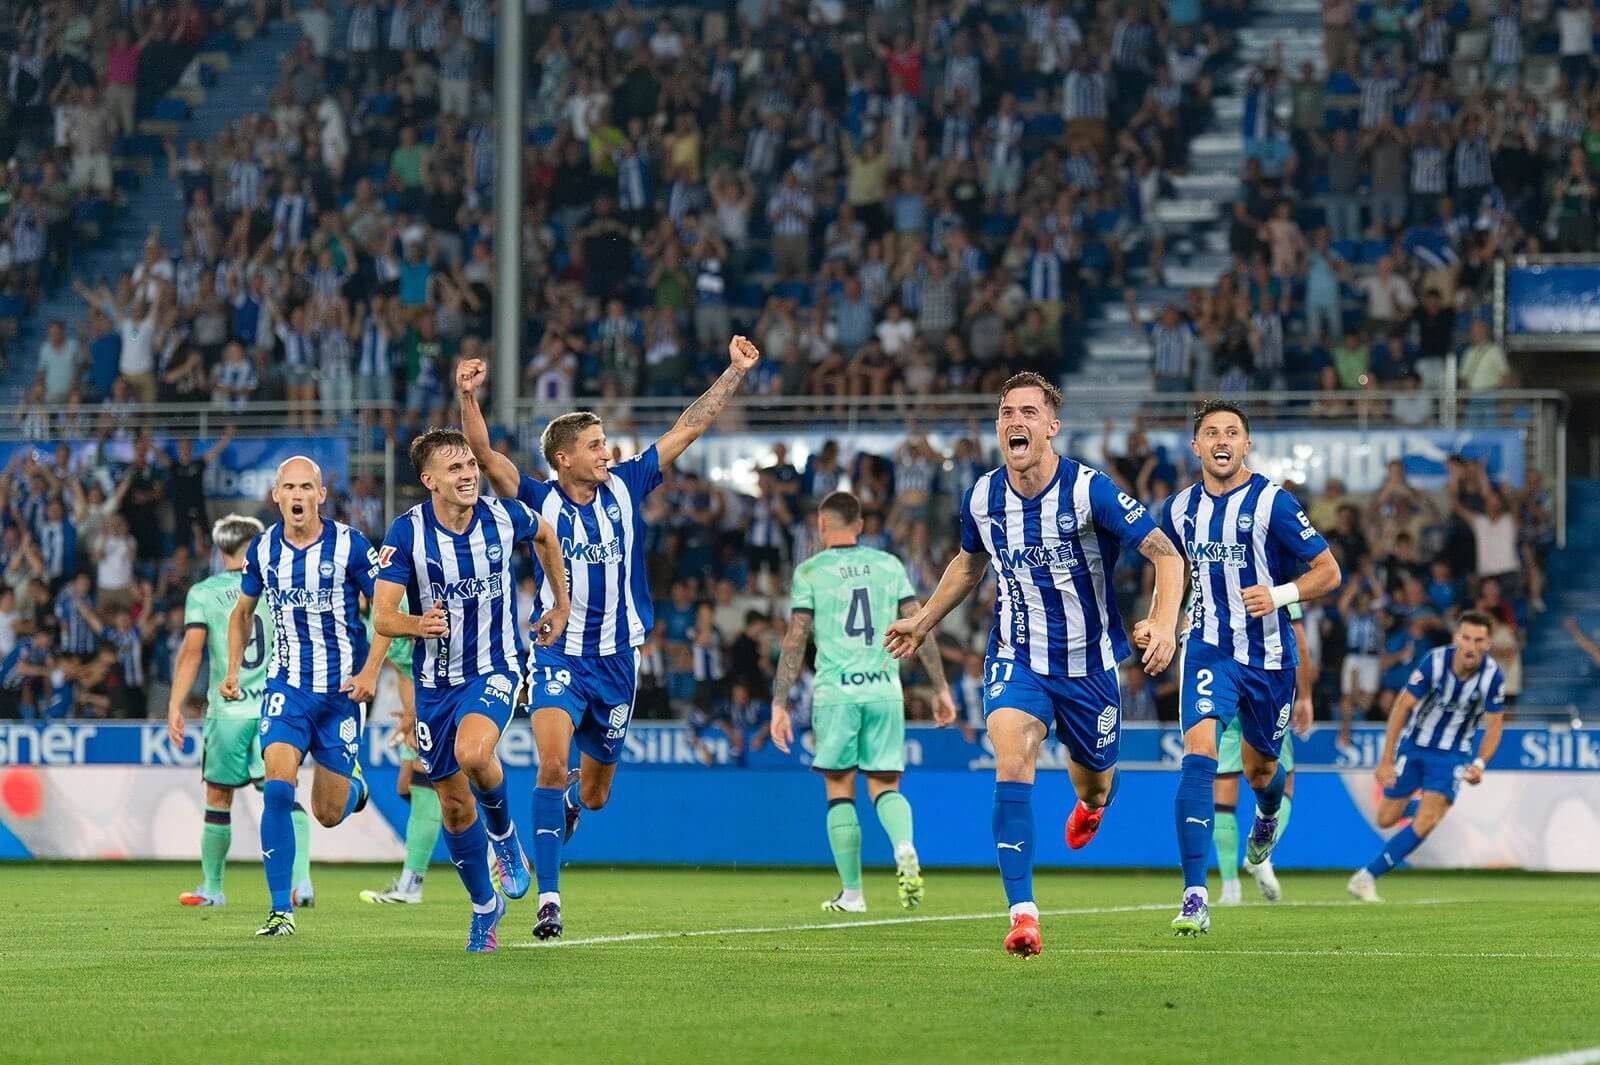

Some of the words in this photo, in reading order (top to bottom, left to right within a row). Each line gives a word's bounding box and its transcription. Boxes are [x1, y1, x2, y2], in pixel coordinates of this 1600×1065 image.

[839, 564, 871, 579] DELA
[1055, 559, 1079, 571] NEWS
[845, 587, 875, 646] 4
[1014, 611, 1026, 645] araba
[544, 666, 571, 686] 19
[1197, 668, 1214, 696] 2
[485, 686, 510, 705] EMB
[418, 721, 434, 752] 9
[606, 728, 625, 739] EMB
[1097, 731, 1116, 749] EMB
